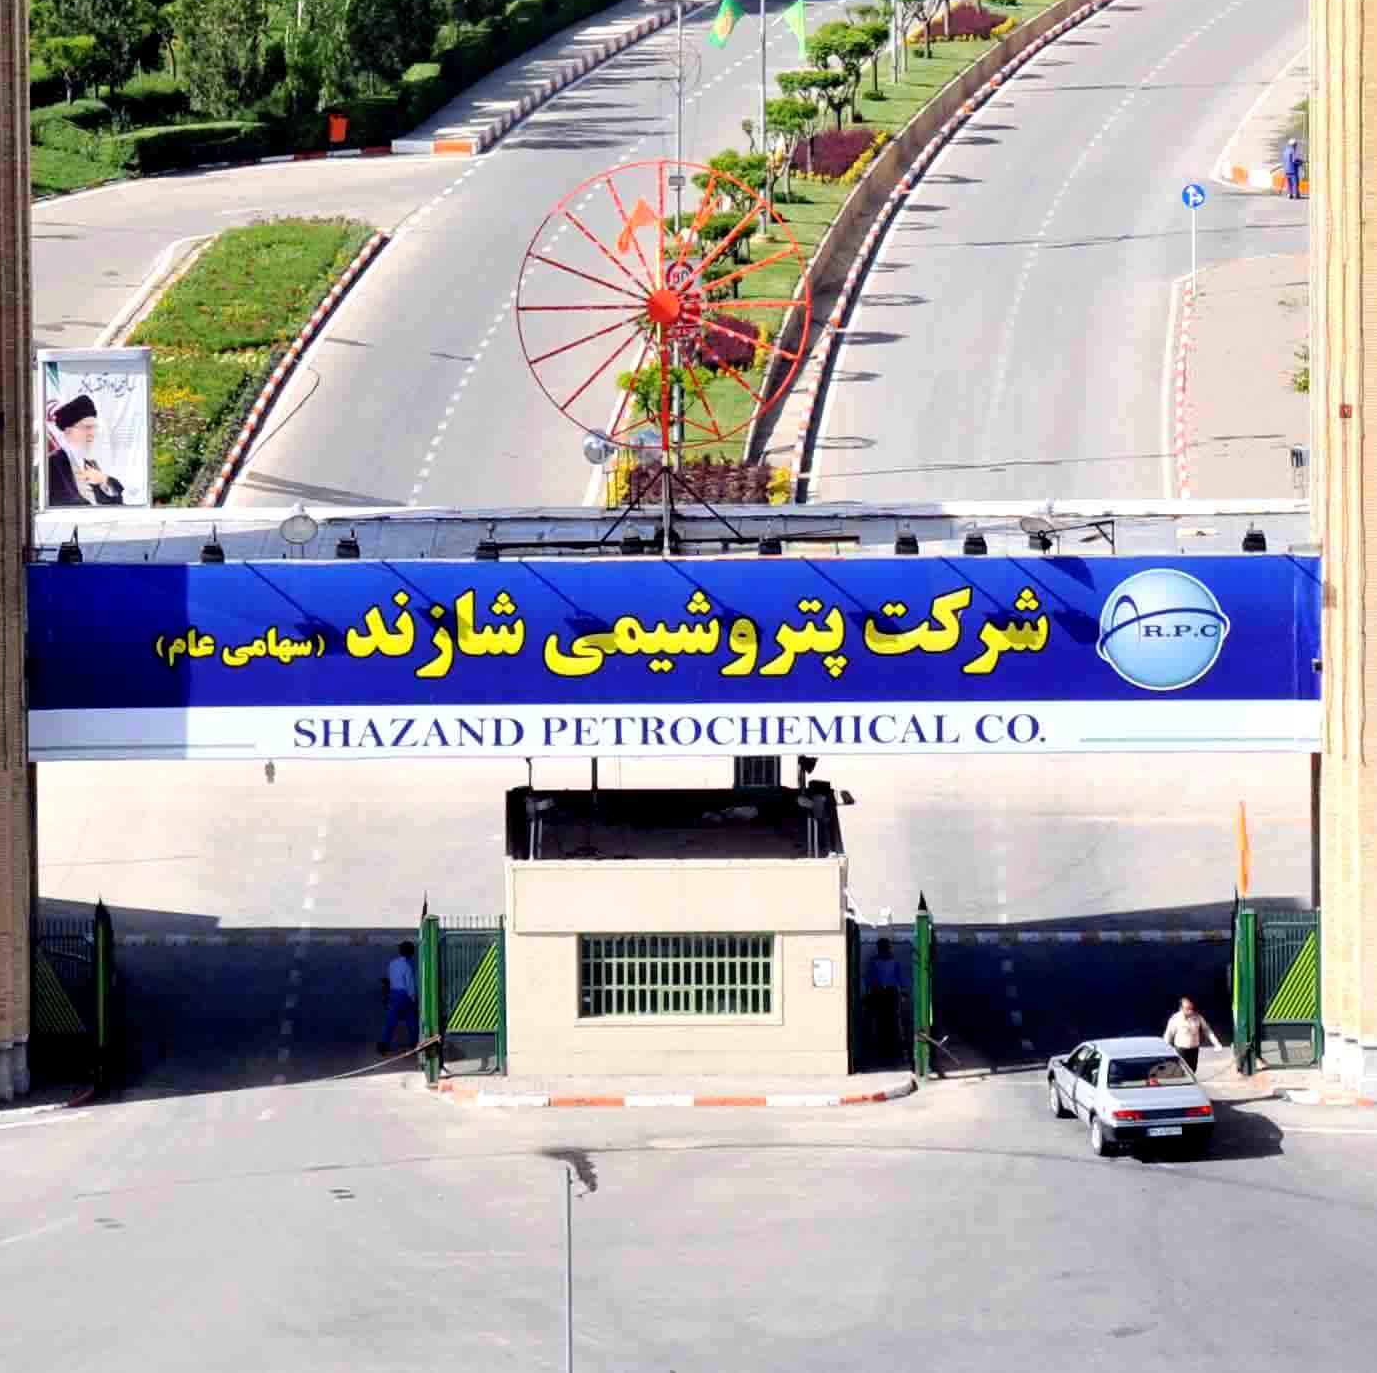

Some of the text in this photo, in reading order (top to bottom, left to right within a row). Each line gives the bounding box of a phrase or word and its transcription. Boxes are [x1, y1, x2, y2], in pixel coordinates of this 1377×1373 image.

[345, 590, 526, 679] شازند
[543, 590, 848, 679] پتروشیمی
[863, 587, 1050, 675] شرکت
[293, 713, 1047, 748] SHAZAND PETROCHEMICAL CO.
